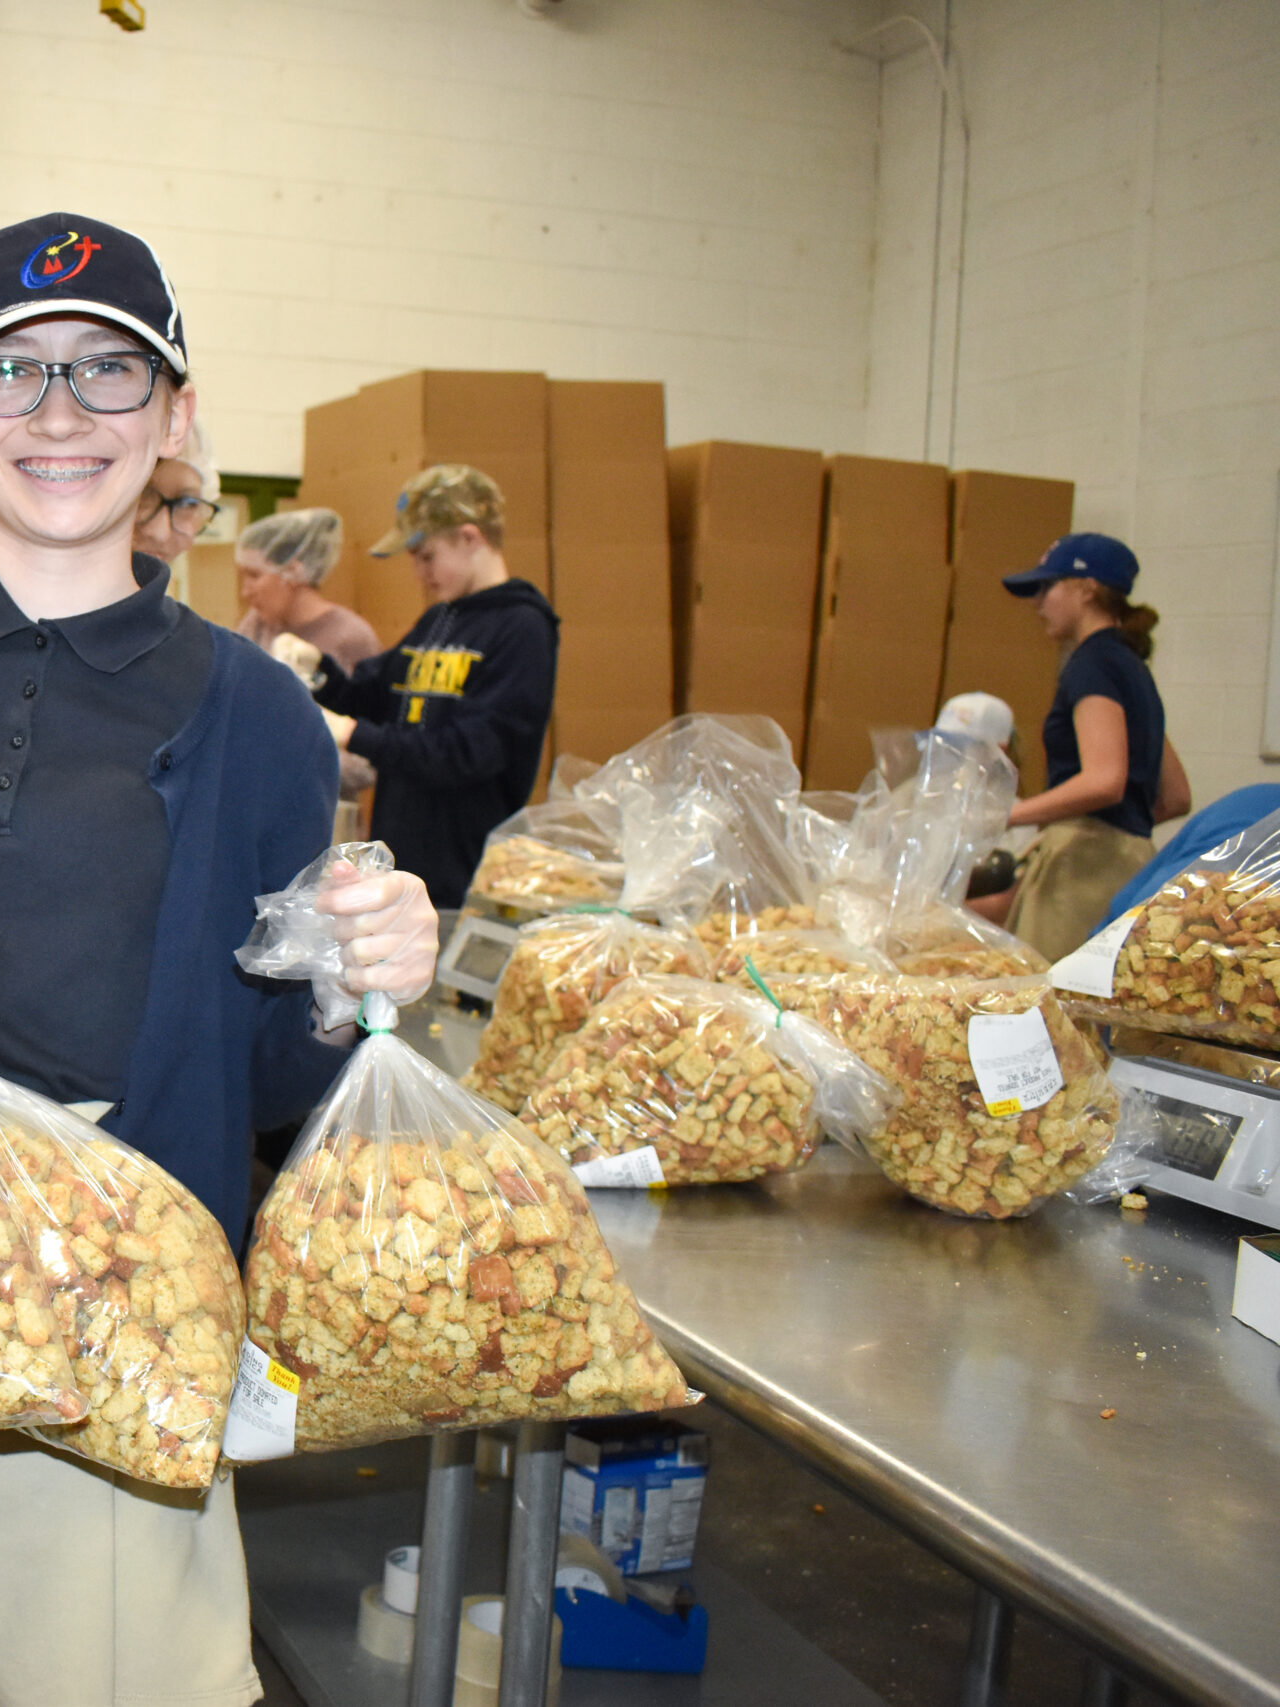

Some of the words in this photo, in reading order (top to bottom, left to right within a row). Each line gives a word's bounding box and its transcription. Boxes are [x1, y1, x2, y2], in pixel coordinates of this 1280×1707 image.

[272, 1365, 296, 1385] Thank
[252, 1393, 265, 1408] SALE
[257, 1385, 279, 1406] DONATED
